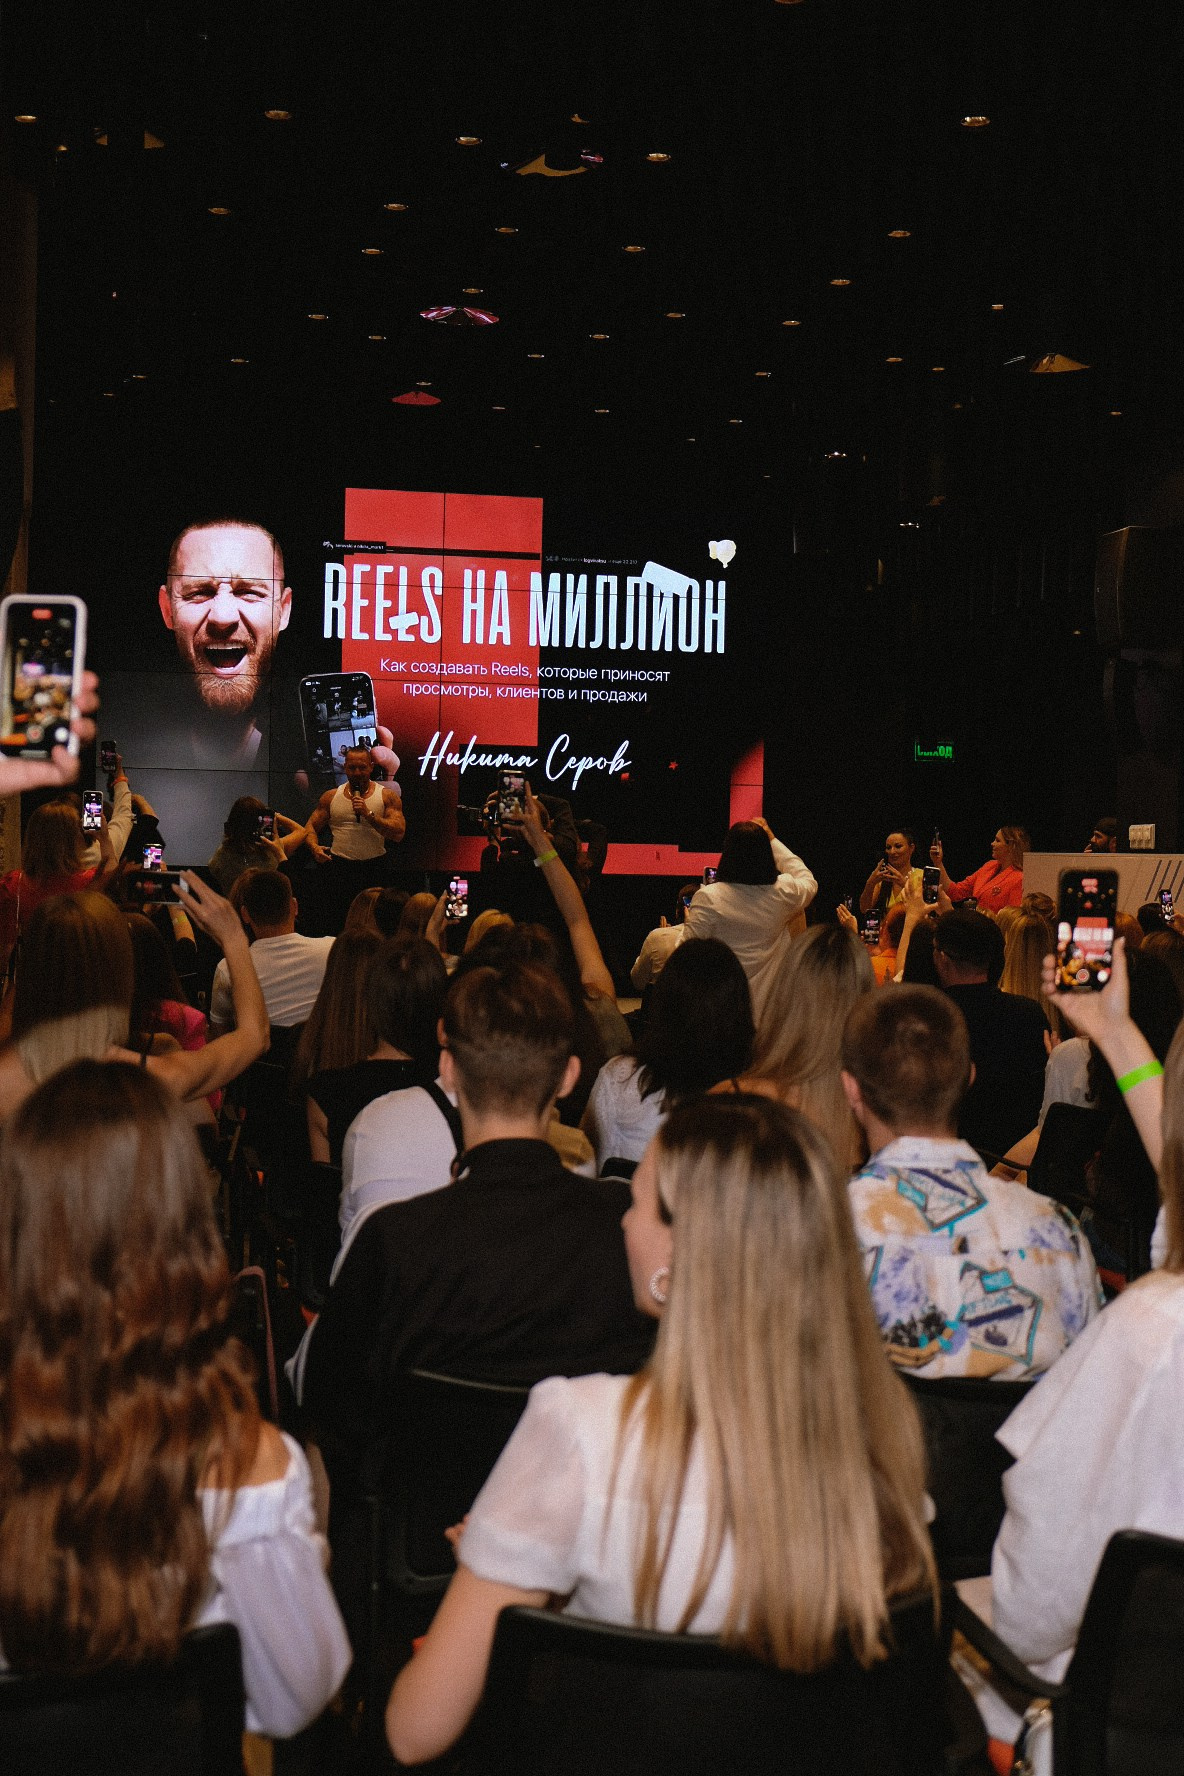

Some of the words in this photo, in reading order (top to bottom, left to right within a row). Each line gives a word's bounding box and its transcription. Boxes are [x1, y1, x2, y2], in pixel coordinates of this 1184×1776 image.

[323, 562, 443, 644] REELS
[462, 568, 511, 646] НА
[528, 570, 726, 654] МИЛЛИОН
[380, 658, 407, 673] Как
[410, 661, 488, 676] создавать
[491, 662, 533, 679] Reels,
[537, 665, 598, 681] которые
[601, 668, 671, 683] приносят
[403, 683, 492, 699] просмотры,
[496, 686, 565, 699] клиентов
[568, 689, 578, 700] и
[581, 689, 648, 703] продажи
[418, 730, 539, 780] Никита
[545, 733, 632, 790] Серов
